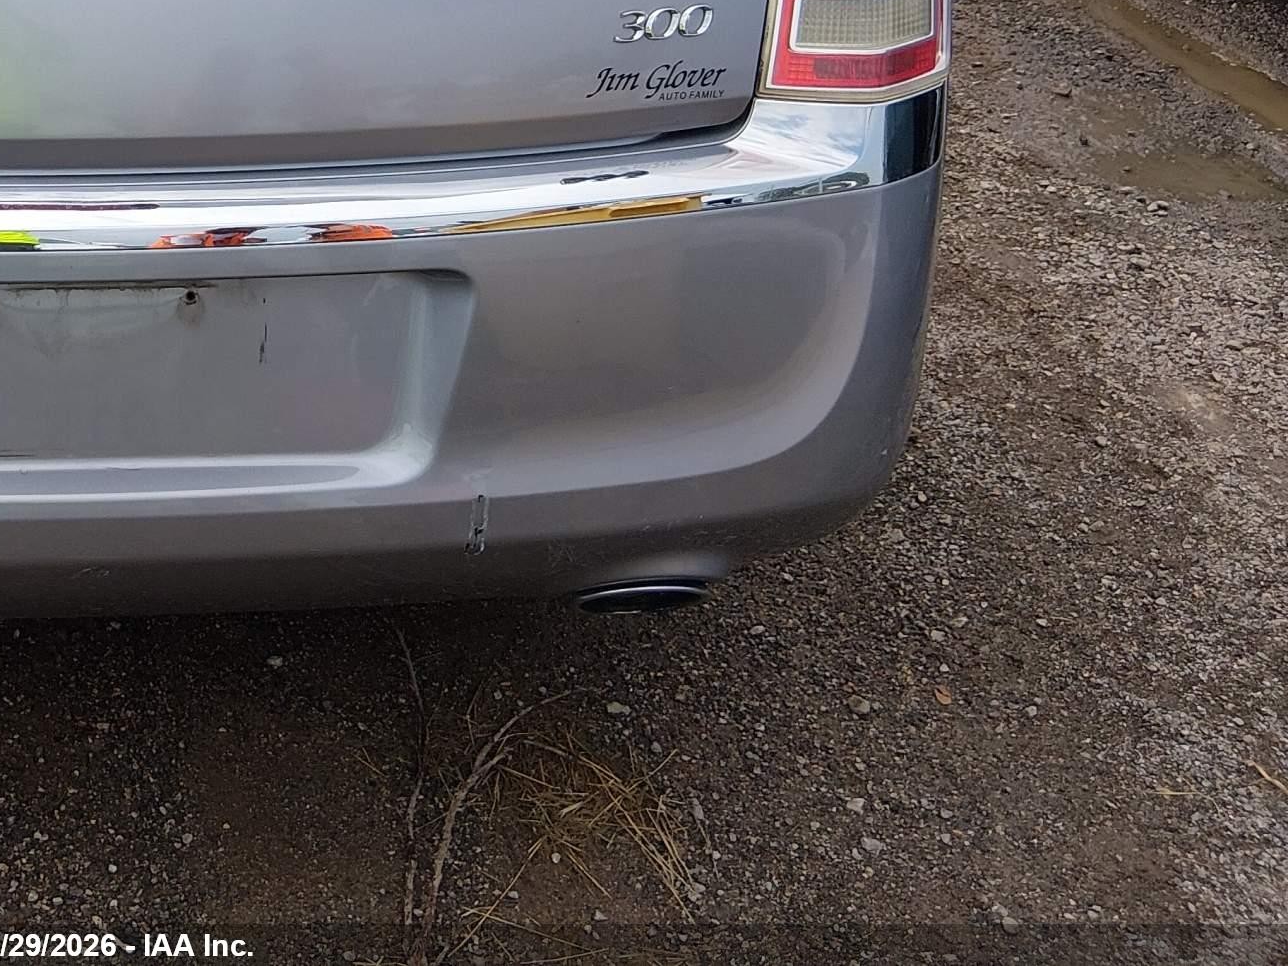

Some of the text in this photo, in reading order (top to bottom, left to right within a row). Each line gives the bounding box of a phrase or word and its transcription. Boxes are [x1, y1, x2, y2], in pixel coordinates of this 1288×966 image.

[613, 4, 714, 44] 300
[585, 59, 727, 99] Jim Glover
[658, 89, 725, 101] AUTO FAMILY
